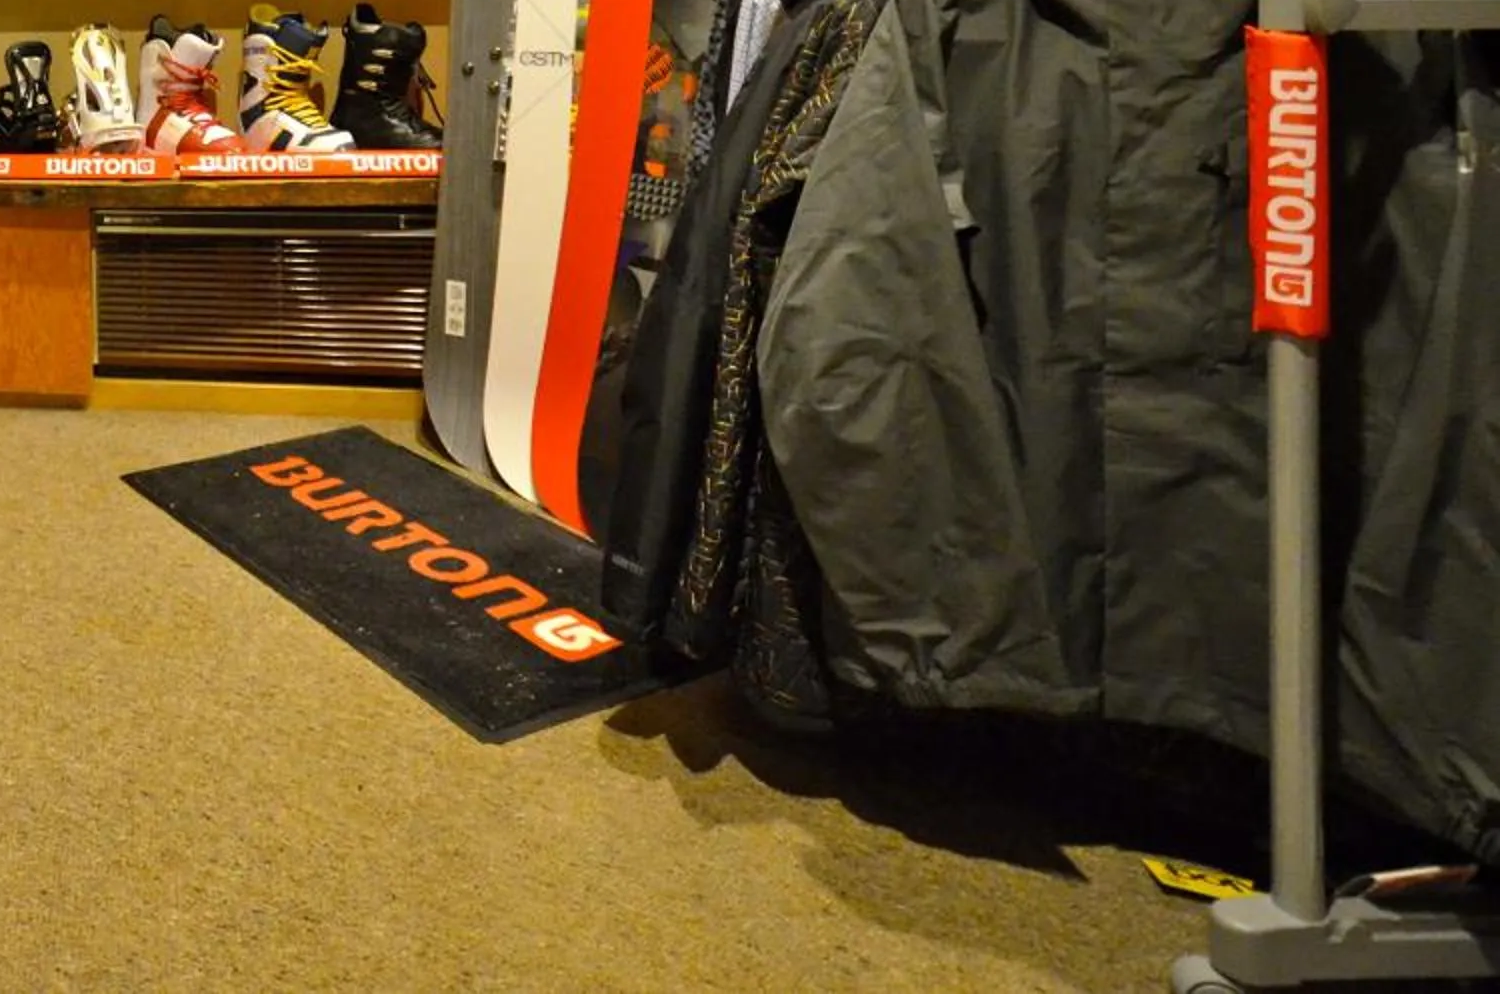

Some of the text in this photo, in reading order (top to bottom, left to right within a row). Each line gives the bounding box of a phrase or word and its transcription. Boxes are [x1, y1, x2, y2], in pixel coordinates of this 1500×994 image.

[46, 157, 138, 175] BURTON
[201, 155, 297, 173] BURTON
[1265, 66, 1319, 273] BURTON
[248, 455, 550, 624] BURTON
